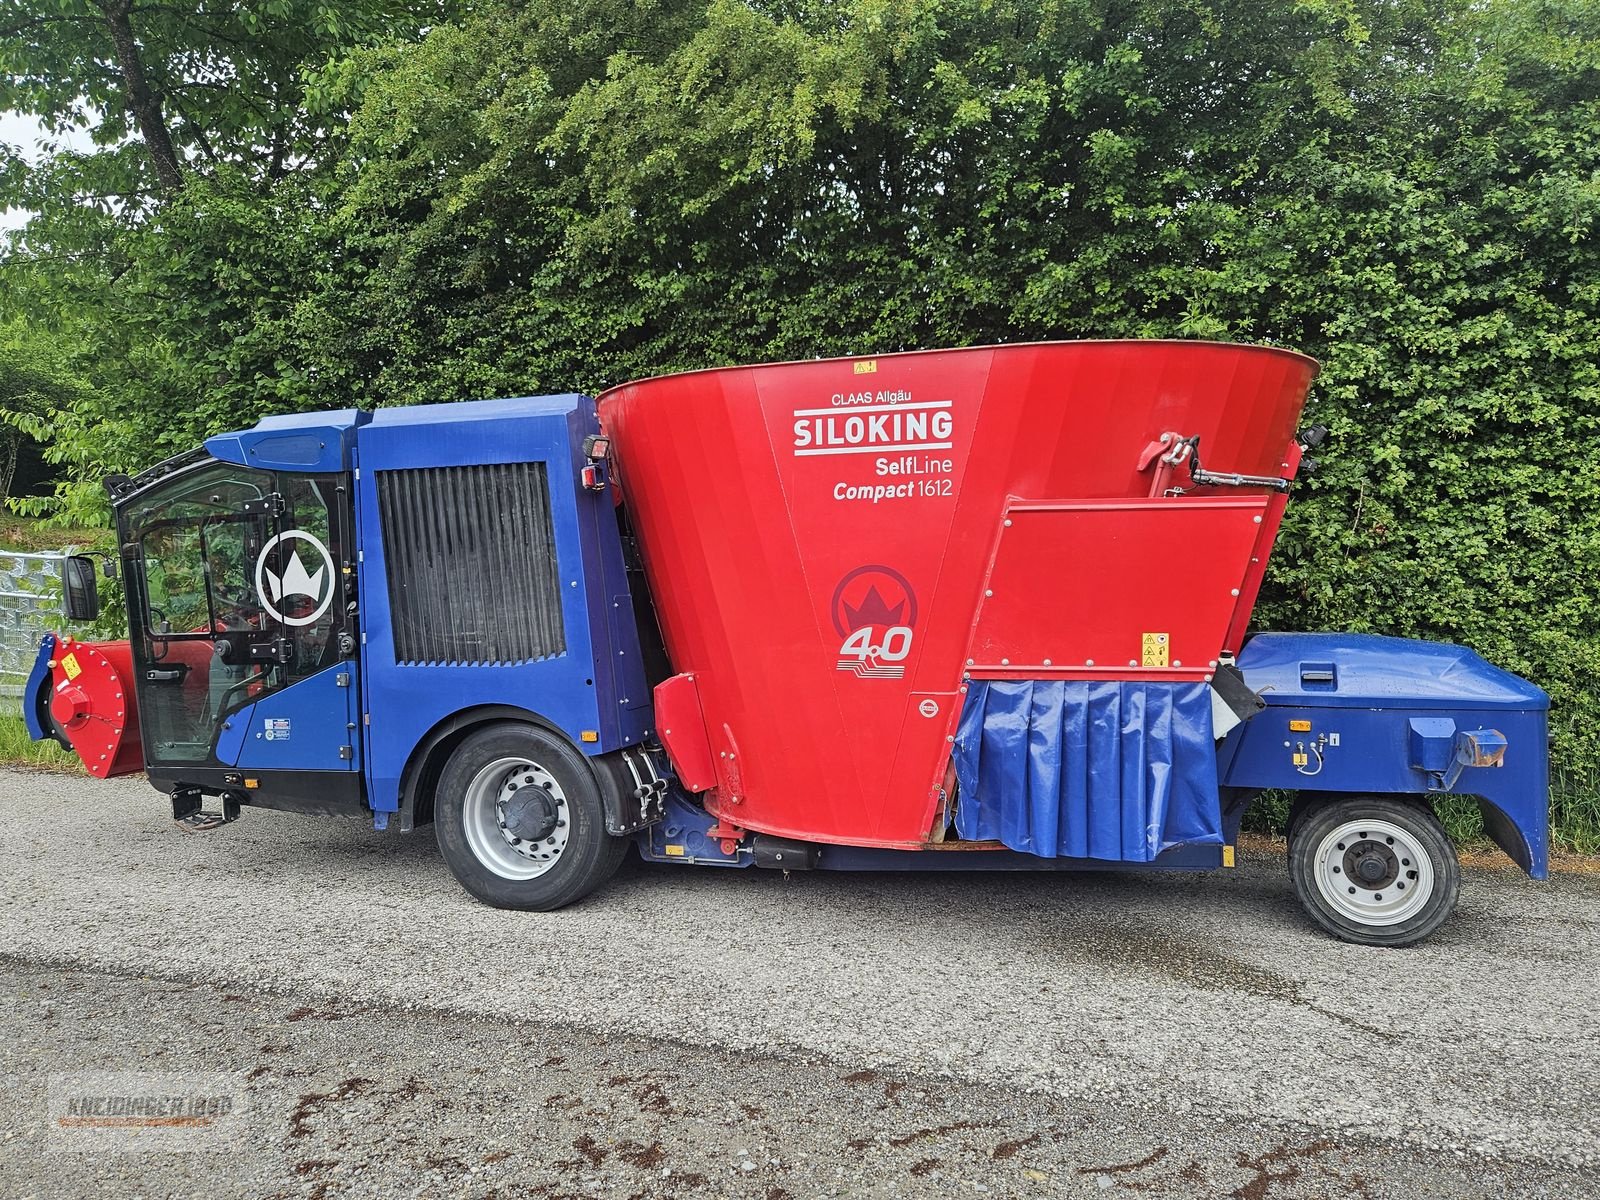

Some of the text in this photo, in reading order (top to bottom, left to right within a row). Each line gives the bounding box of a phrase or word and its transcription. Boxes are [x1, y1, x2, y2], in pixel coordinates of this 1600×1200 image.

[832, 390, 911, 406] CLAAS Allgäu
[794, 411, 953, 447] SILOKING
[875, 456, 953, 476] SelfLine
[833, 479, 953, 504] Compact 1612
